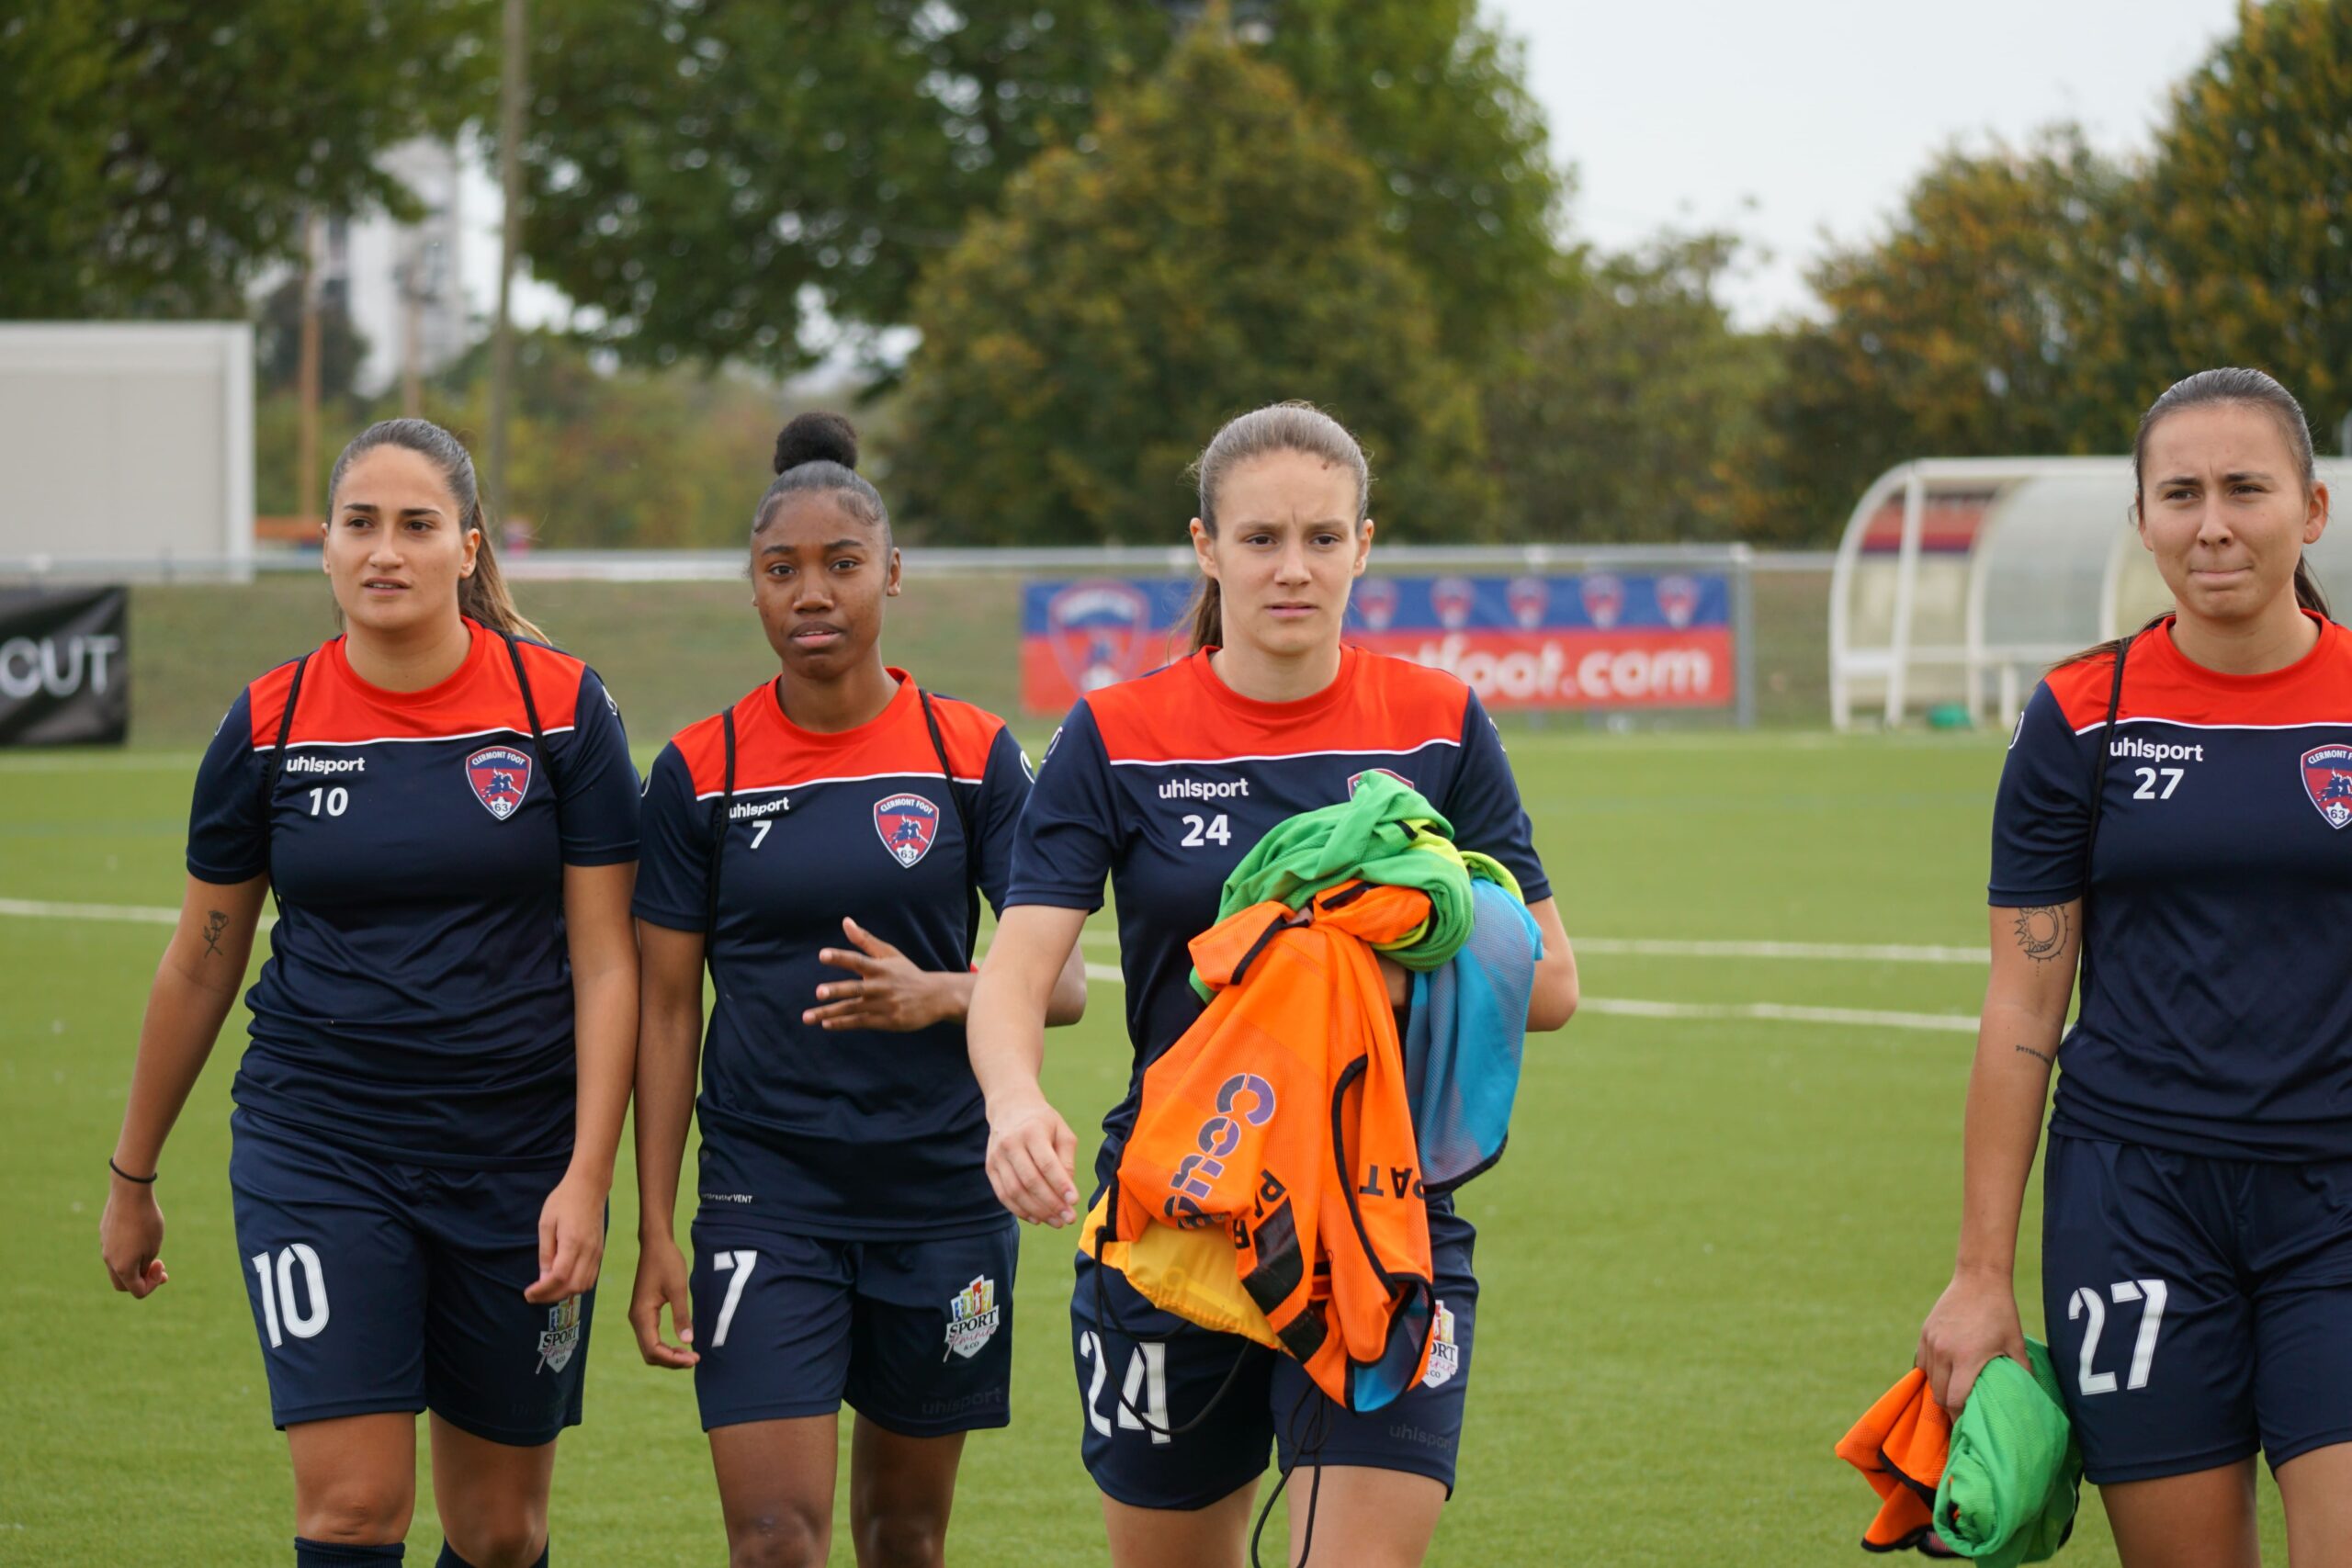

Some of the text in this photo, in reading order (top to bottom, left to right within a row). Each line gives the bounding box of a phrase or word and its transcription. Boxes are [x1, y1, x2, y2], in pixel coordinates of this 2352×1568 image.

[0, 636, 119, 698] CUT
[471, 750, 526, 765] CLERMONT FOOT
[2109, 738, 2204, 762] uhlsport
[2307, 750, 2347, 764] CLERMONT
[287, 756, 366, 774] uhlsport
[1159, 778, 1249, 800] uhlsport
[2132, 767, 2185, 800] 27
[309, 787, 349, 817] 10
[494, 803, 508, 812] 63
[729, 796, 790, 819] uhlsport
[880, 797, 933, 815] CLERMONT FOOT
[2330, 809, 2346, 819] 63
[750, 820, 772, 849] 7
[1181, 814, 1231, 847] 24
[900, 850, 915, 859] 63
[252, 1243, 330, 1348] 10
[711, 1250, 757, 1348] 7
[949, 1309, 997, 1338] SPORT
[543, 1324, 579, 1348] SPORT
[2068, 1280, 2168, 1396] 27
[1080, 1330, 1171, 1444] 24
